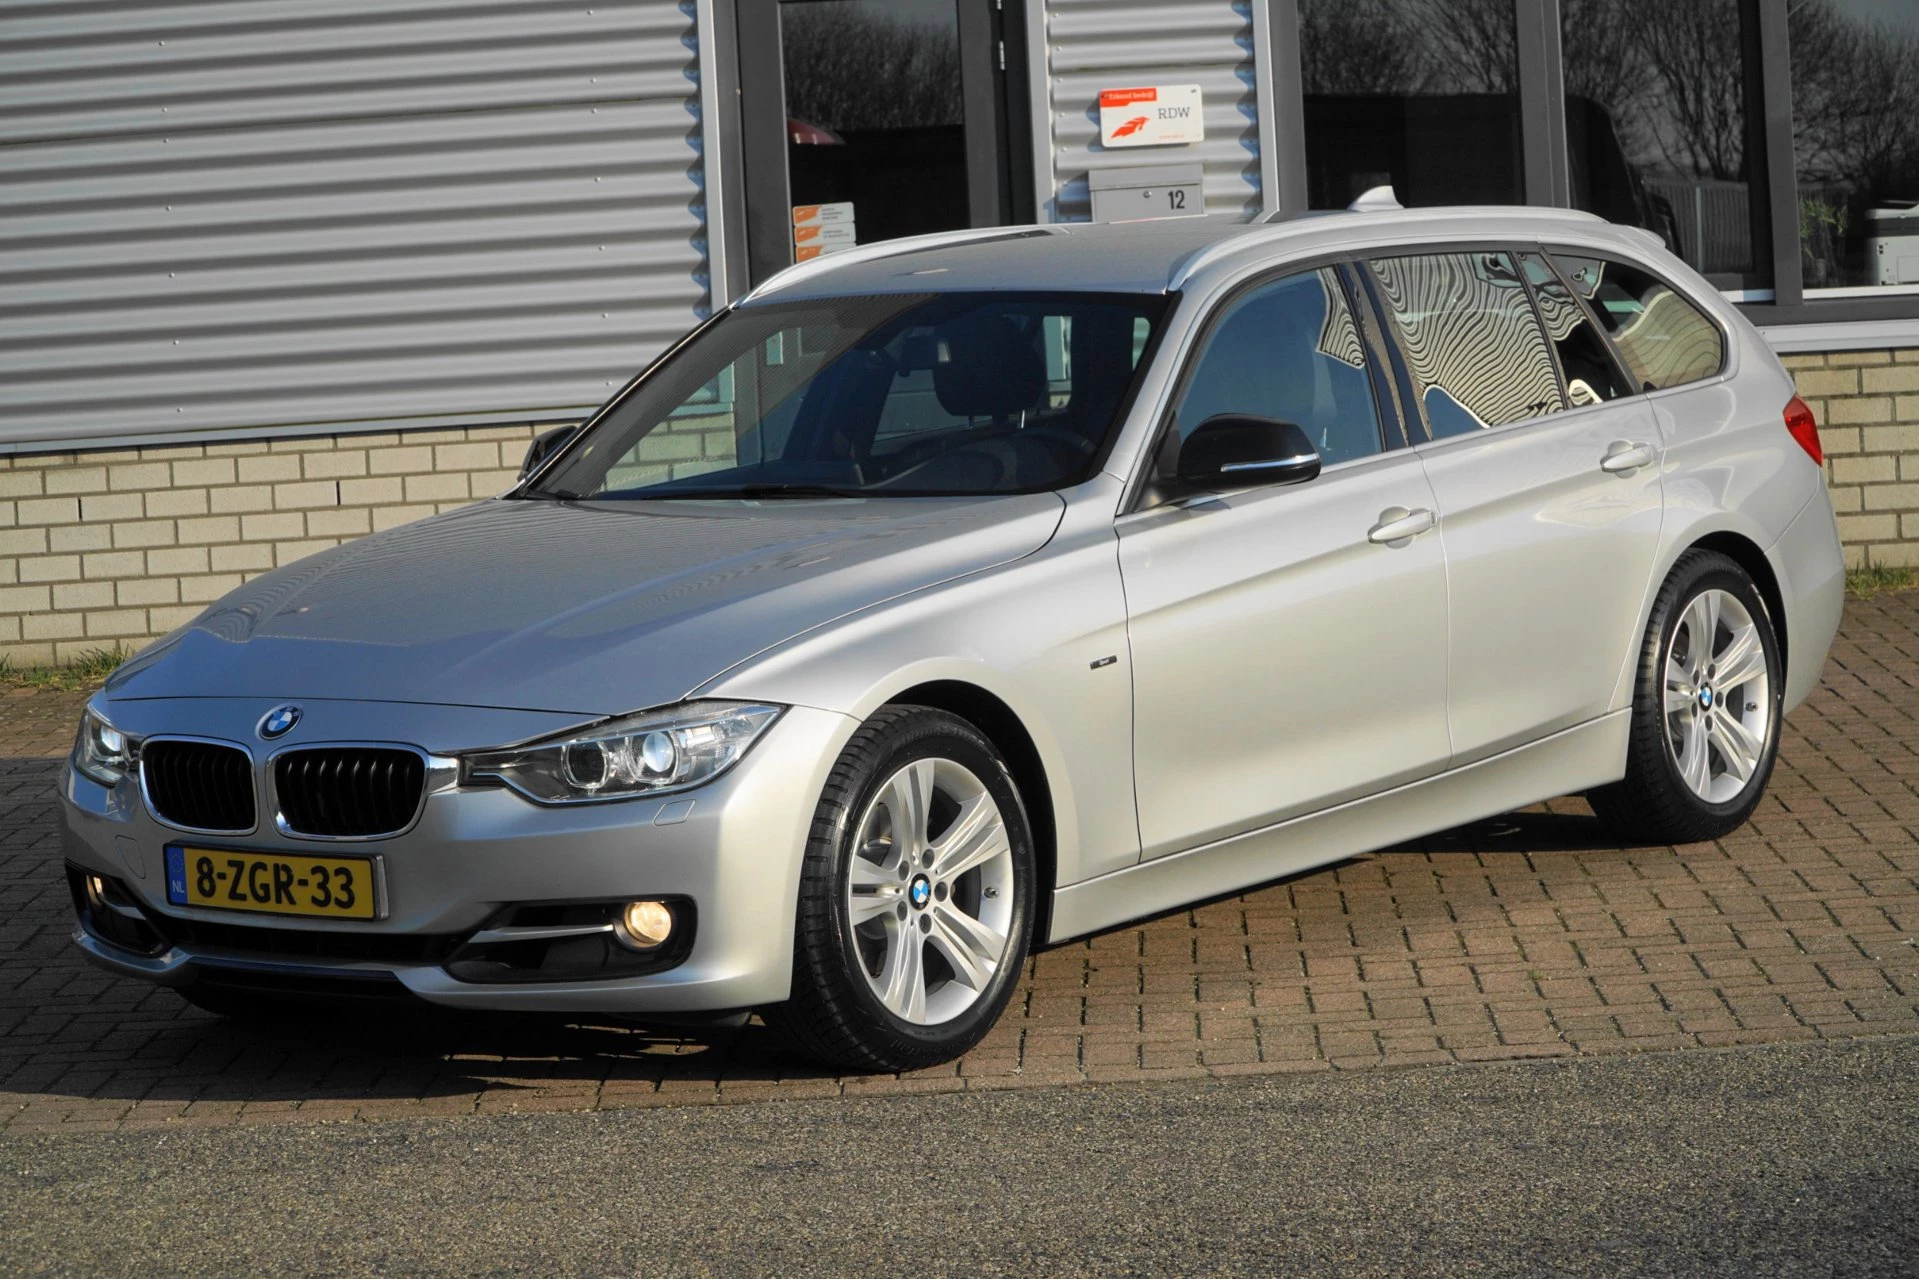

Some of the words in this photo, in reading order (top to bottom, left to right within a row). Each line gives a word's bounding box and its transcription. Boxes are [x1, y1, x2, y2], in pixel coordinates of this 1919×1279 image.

[1158, 106, 1191, 120] RDW
[1168, 190, 1185, 210] 12
[172, 879, 185, 893] NL
[196, 856, 356, 909] 8-ZGR-33
